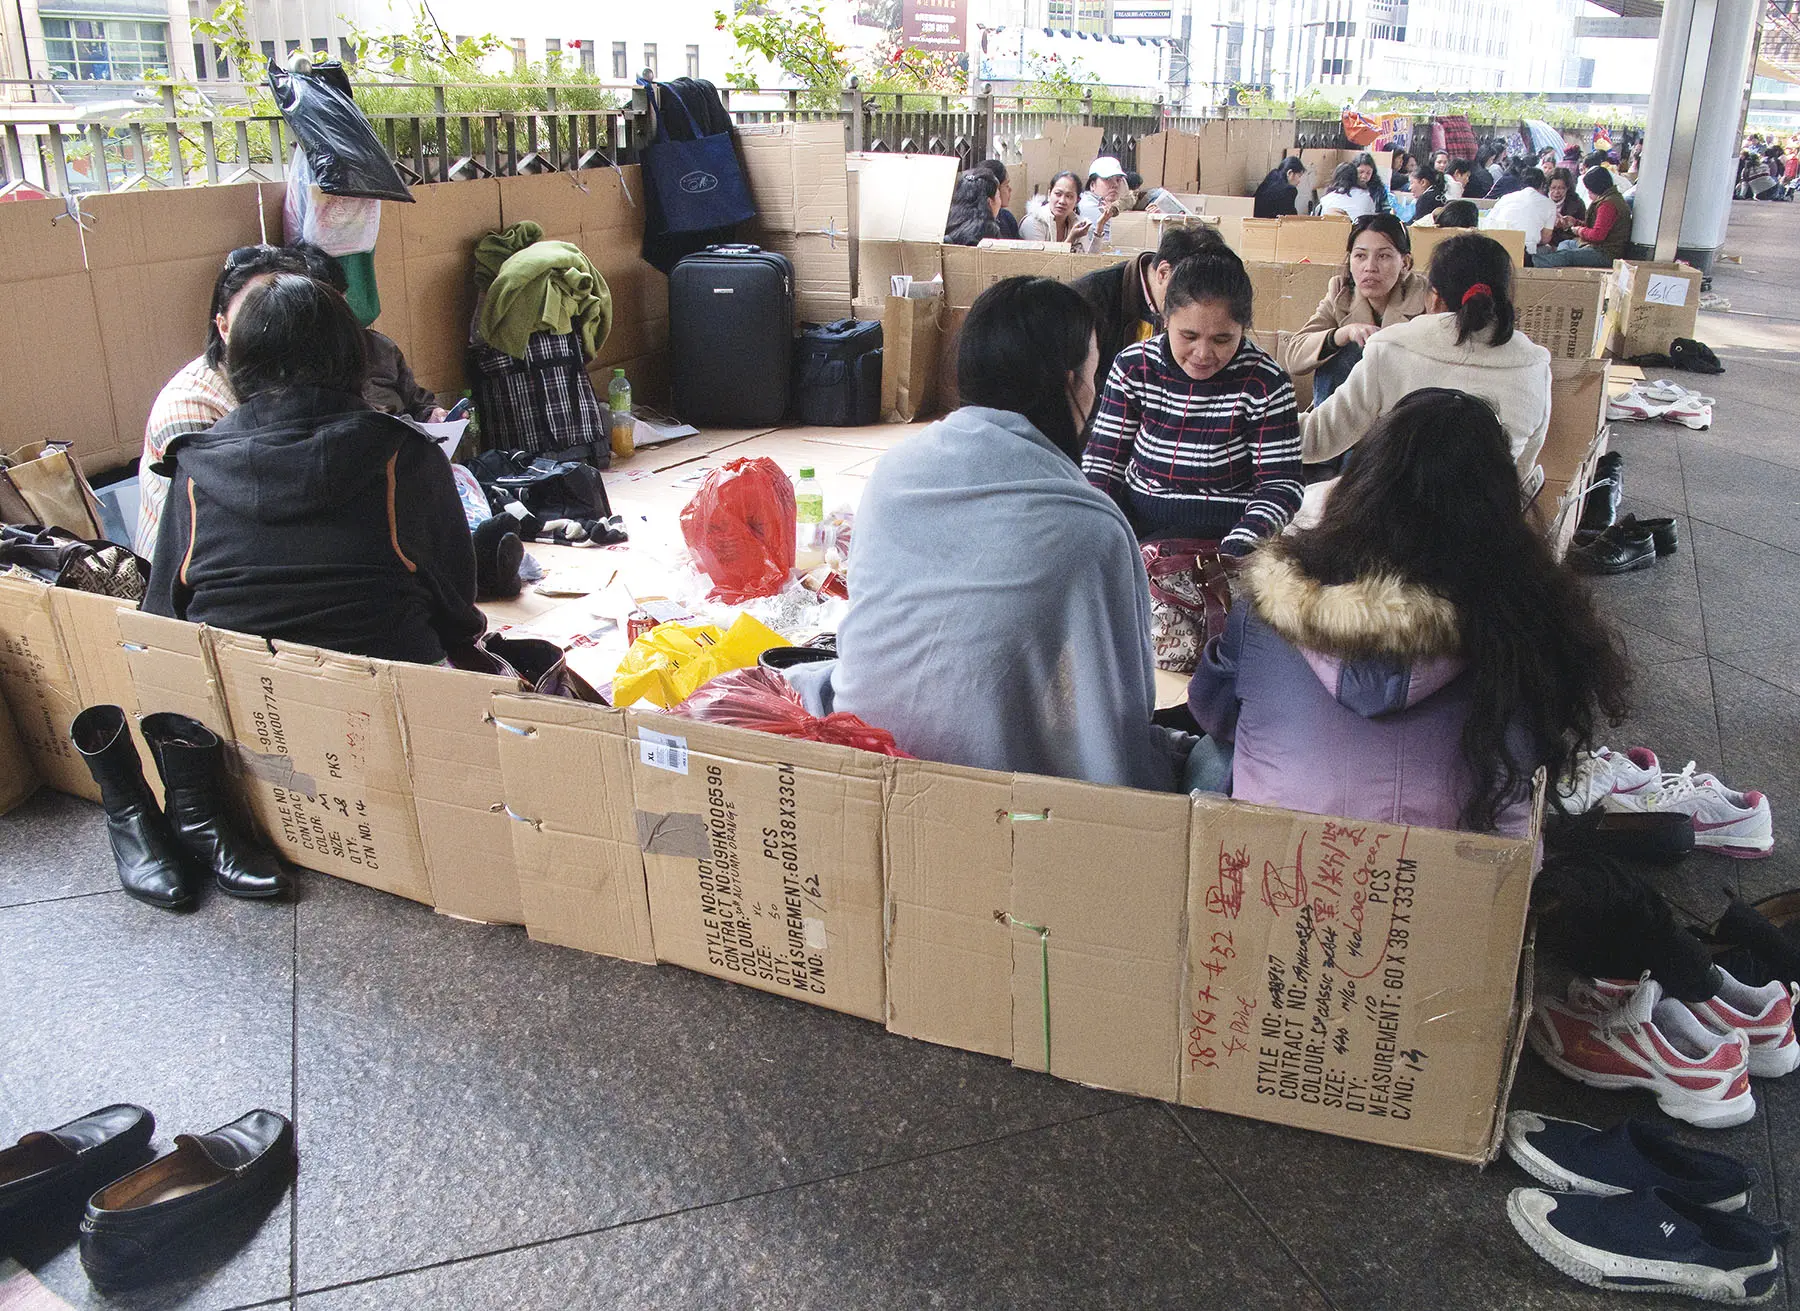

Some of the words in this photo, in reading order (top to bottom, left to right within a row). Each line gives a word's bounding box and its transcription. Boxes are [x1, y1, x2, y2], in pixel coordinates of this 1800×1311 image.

[253, 712, 271, 752] -9036
[261, 677, 288, 754] 9HK007743
[325, 753, 342, 779] PKS
[648, 752, 654, 761] XL
[278, 807, 298, 843] STYLE
[310, 816, 329, 854] COLOR:
[329, 831, 345, 858] SIZE:
[358, 823, 372, 841] NO:
[725, 801, 737, 849] ORANGE
[763, 827, 779, 860] PCS
[346, 837, 362, 864] QTY:
[364, 846, 379, 870] CTN
[728, 852, 744, 900] AUTUMN
[1369, 869, 1390, 903] PCS
[704, 919, 724, 966] STYLE
[718, 899, 740, 971] CONTRACT
[737, 916, 757, 976] COLOUR:
[757, 945, 774, 980] SIZE:
[775, 954, 791, 985] QTY:
[811, 953, 825, 994] C/NO:
[1288, 983, 1308, 1010] NO:
[1314, 973, 1334, 1017] CLASSIC
[1262, 1011, 1282, 1037] NO:
[1256, 1046, 1281, 1095] STYLE
[1279, 1019, 1304, 1099] CONTRACT
[1302, 1038, 1326, 1104] COLOUR:
[1370, 994, 1402, 1117] MEASUREMENT:
[1323, 1068, 1345, 1108] SIZE:
[1346, 1077, 1368, 1112] QTY:
[1391, 1075, 1415, 1120] C/NO:
